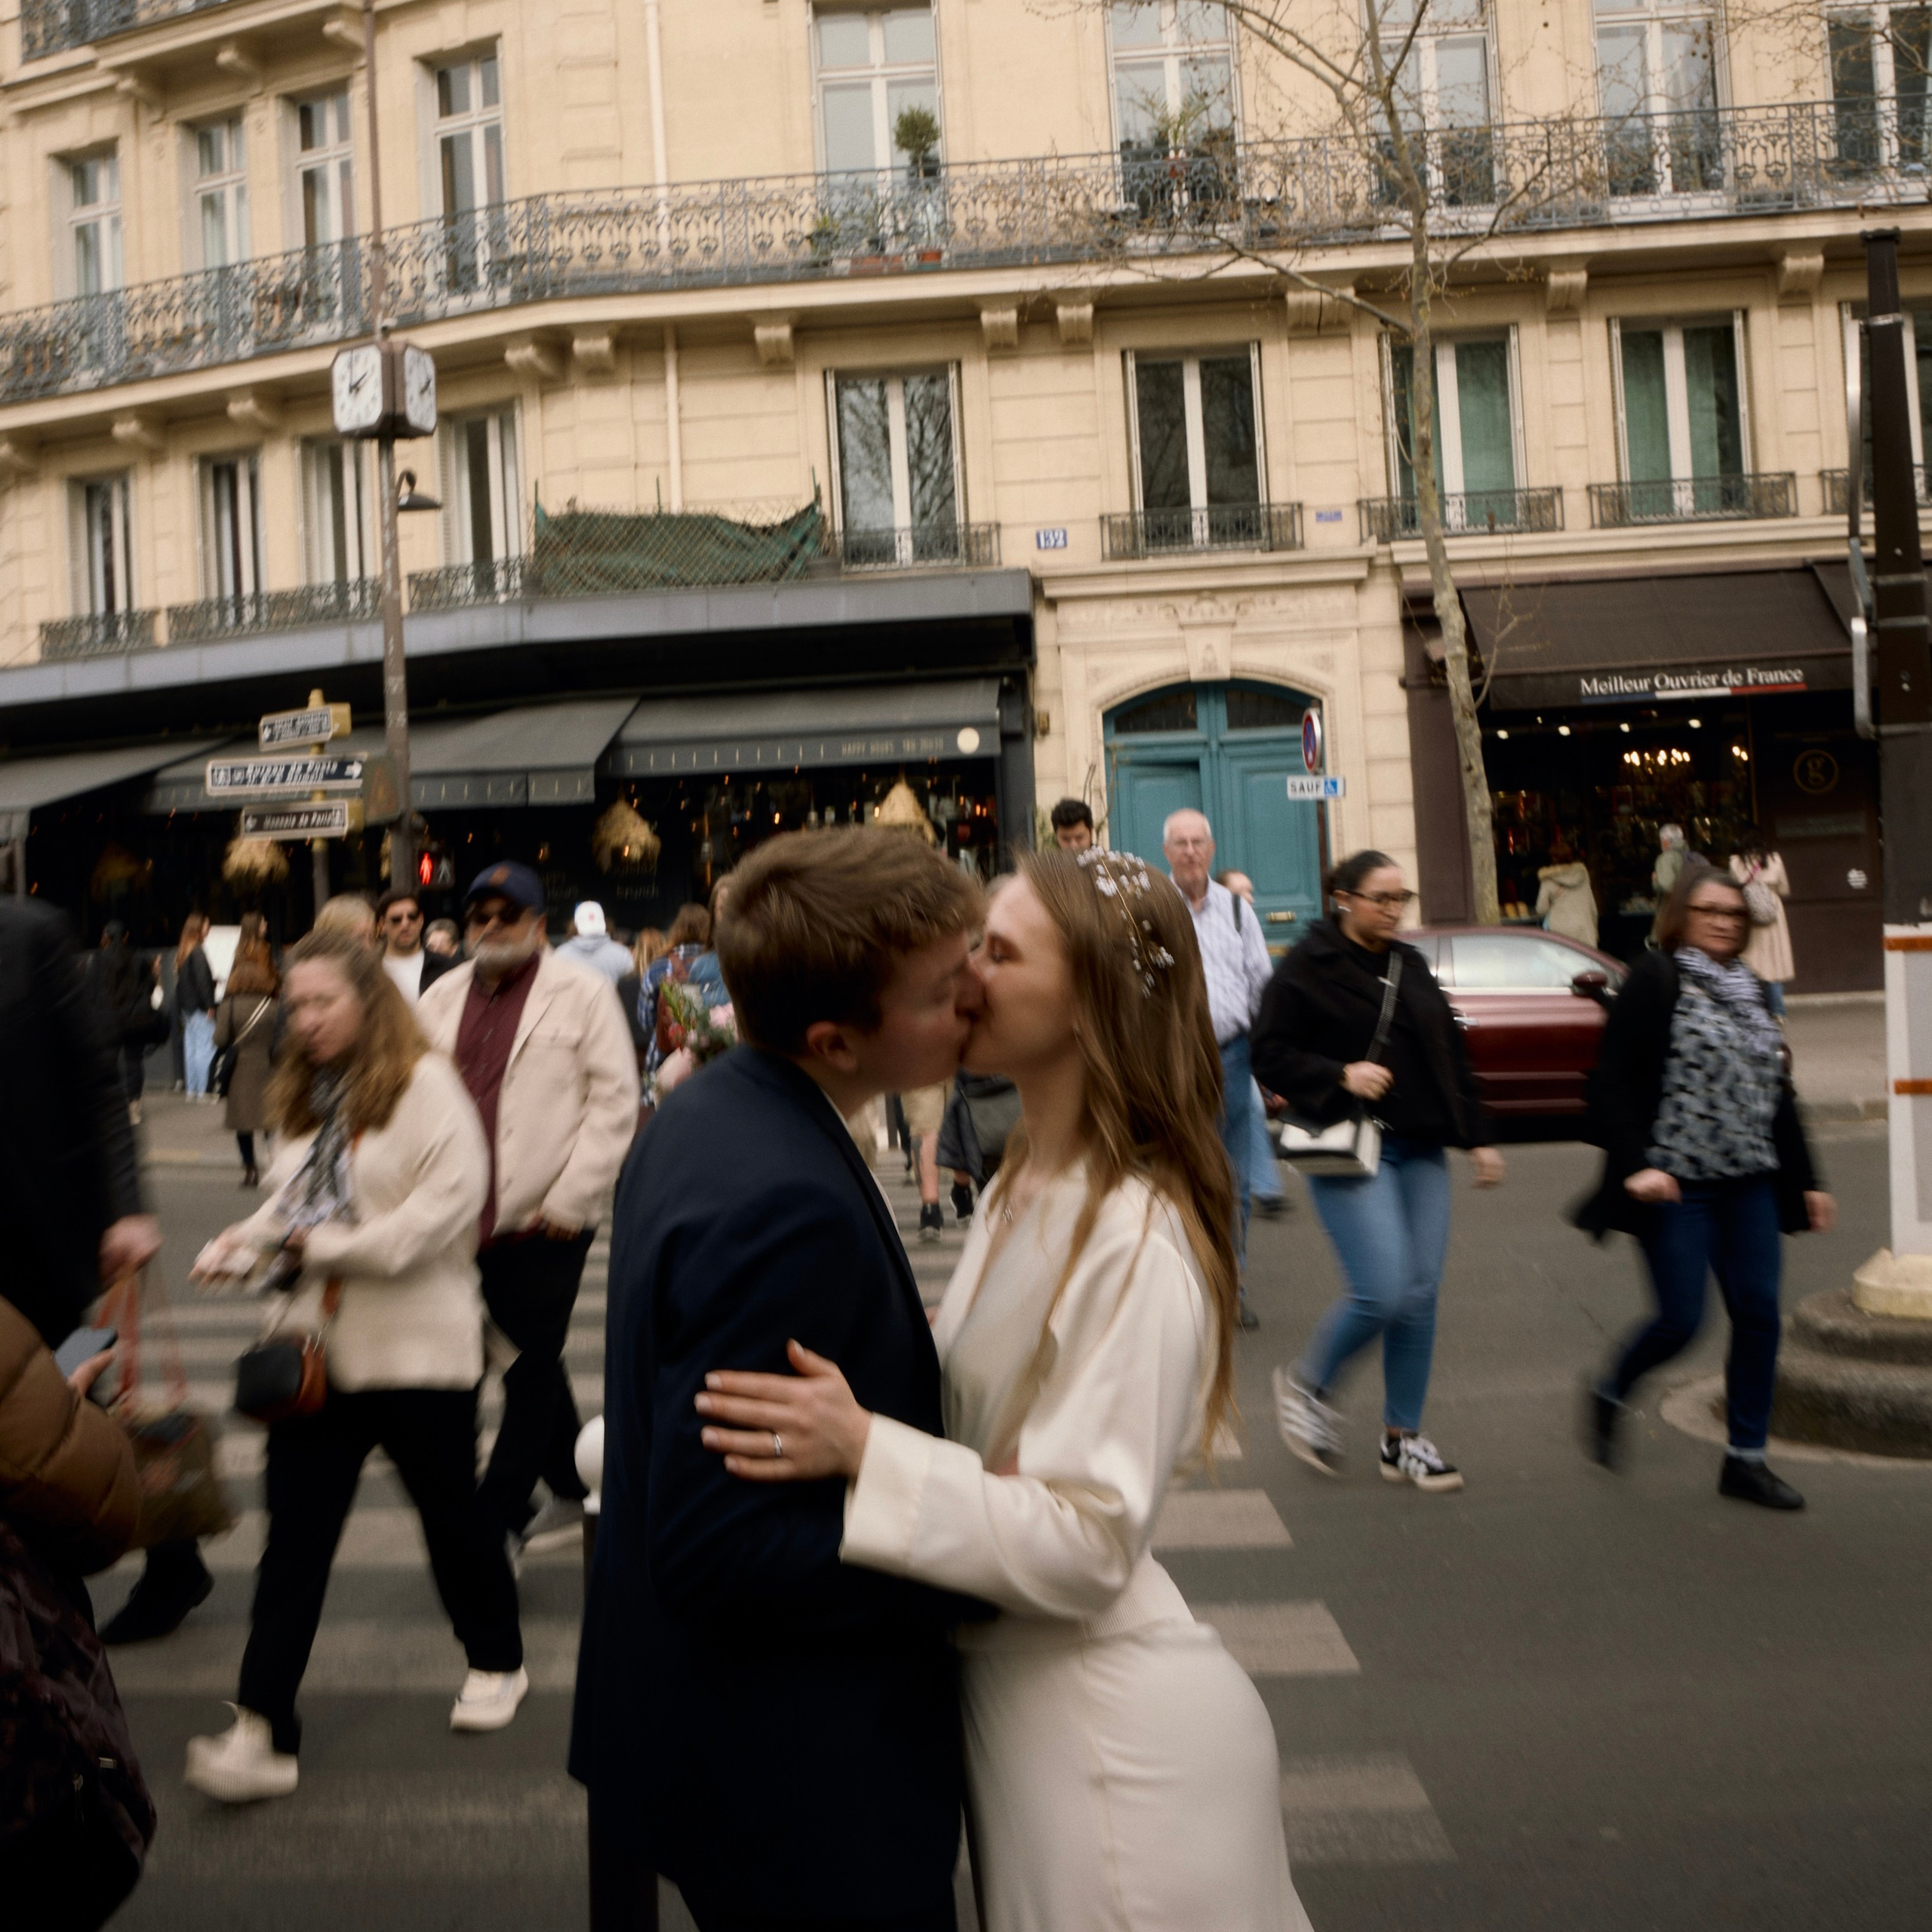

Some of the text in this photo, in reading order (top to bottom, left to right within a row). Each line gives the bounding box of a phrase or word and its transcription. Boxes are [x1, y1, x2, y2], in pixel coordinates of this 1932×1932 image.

[1039, 530, 1065, 548] 132
[1580, 667, 1804, 696] Meilleur Ouvrier de France
[306, 760, 338, 775] Poste
[1290, 781, 1321, 793] SAUF
[298, 812, 309, 829] de
